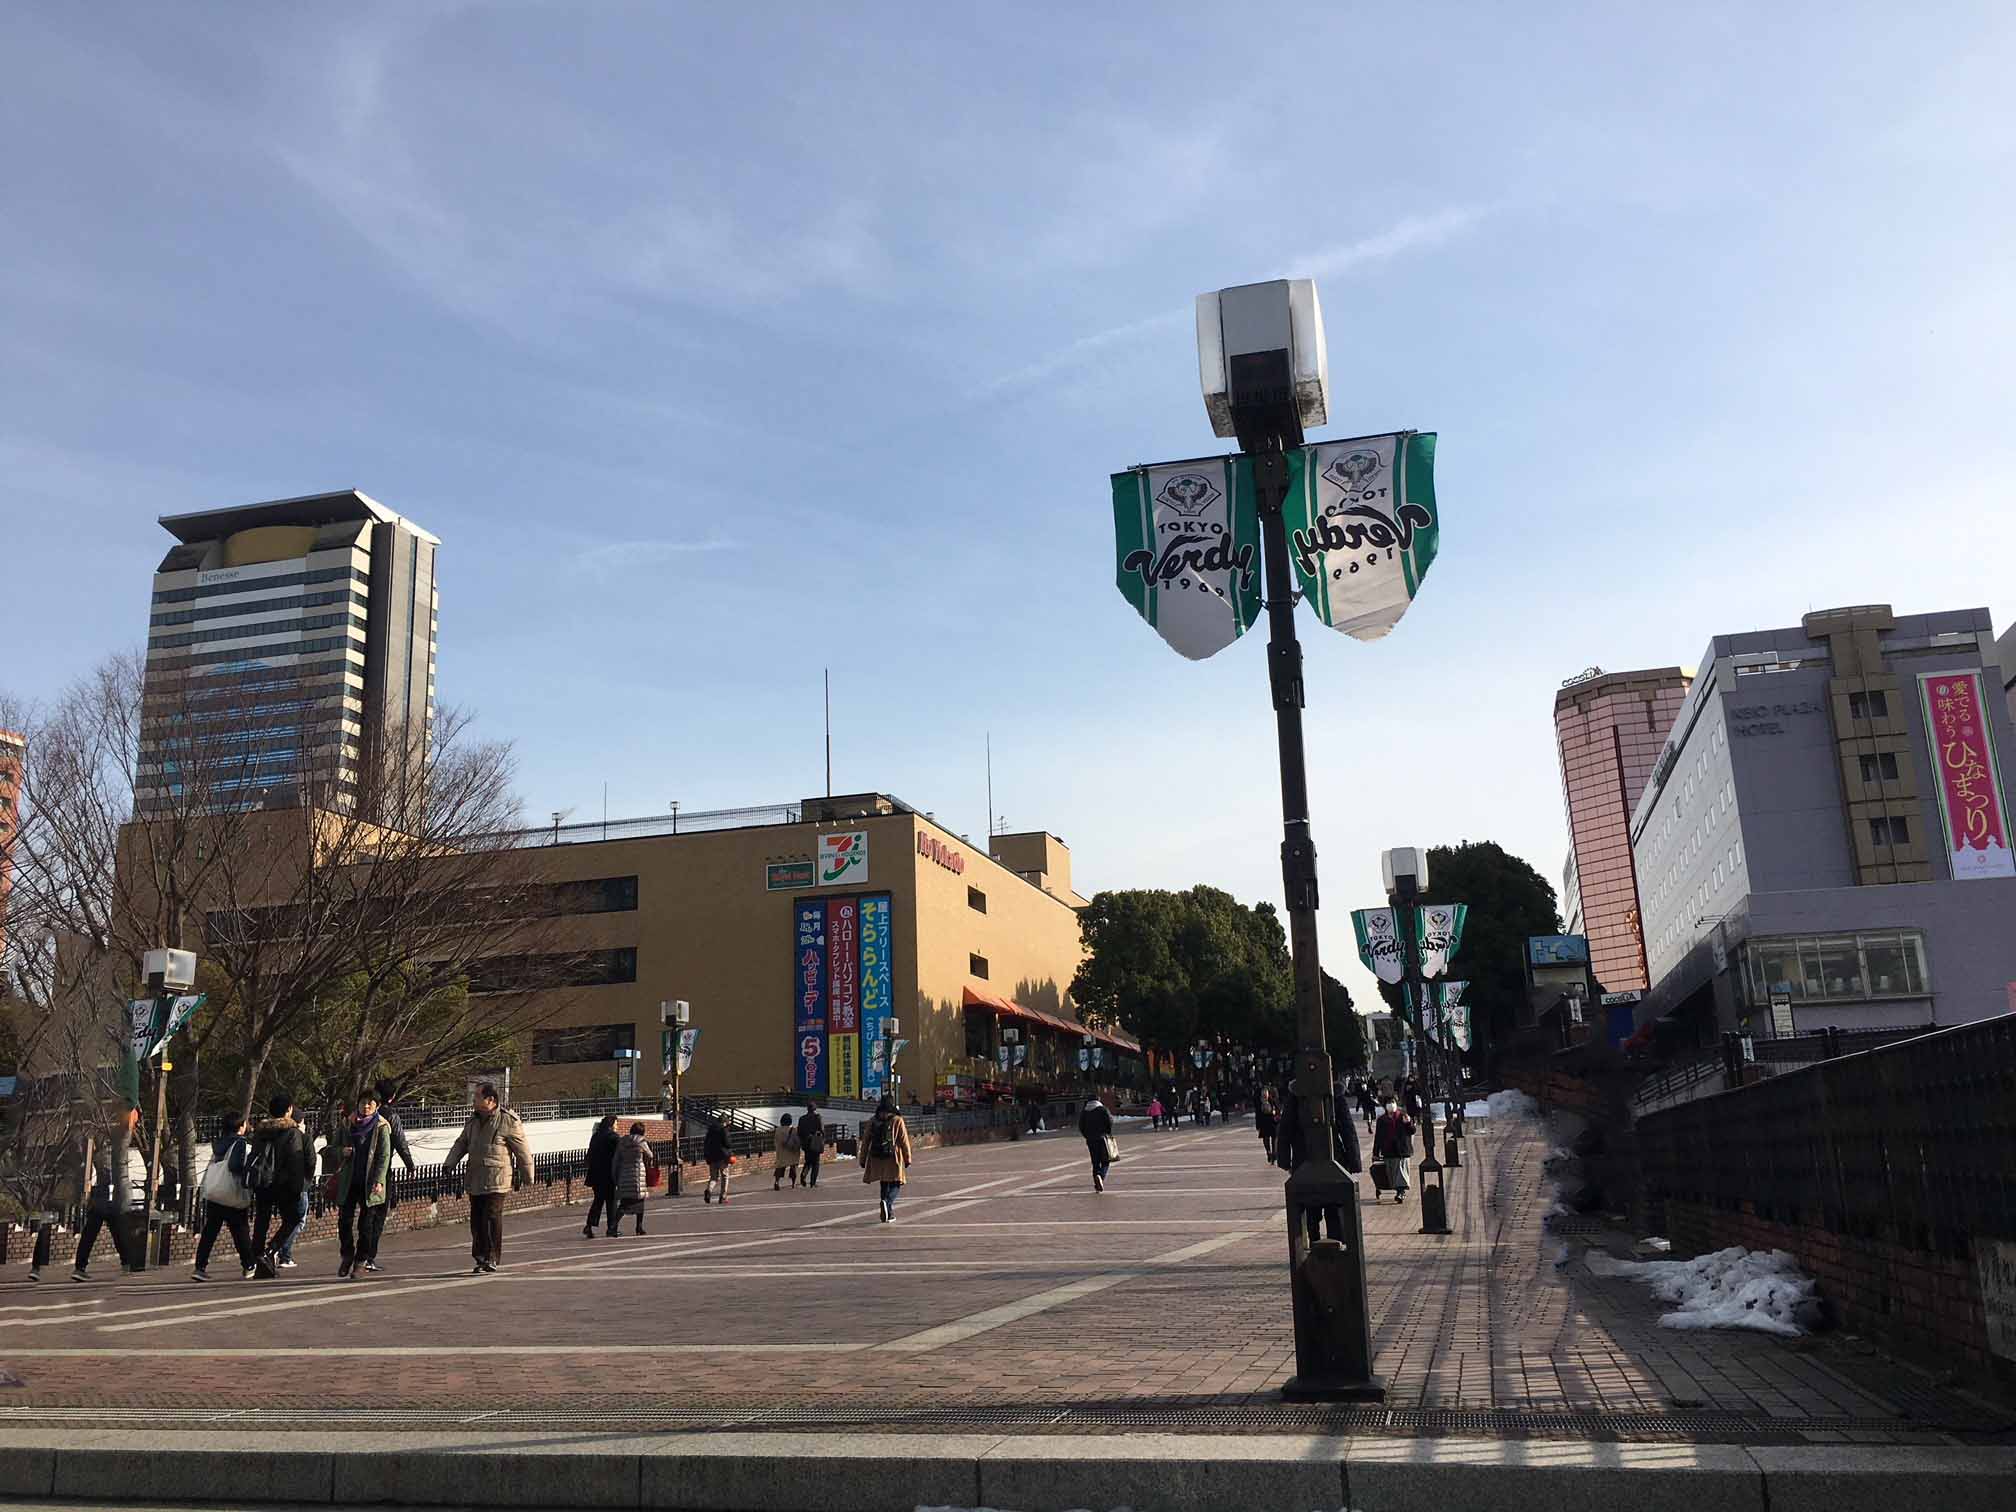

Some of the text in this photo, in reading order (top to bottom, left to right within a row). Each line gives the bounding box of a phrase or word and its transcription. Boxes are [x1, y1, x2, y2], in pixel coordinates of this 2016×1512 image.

[1159, 521, 1223, 535] TOKYO
[200, 569, 240, 584] Benesse
[1122, 532, 1255, 591] Verdy
[1163, 578, 1225, 597] 1969
[1942, 741, 1989, 841] ひなまつり
[863, 902, 878, 1009] そららんど
